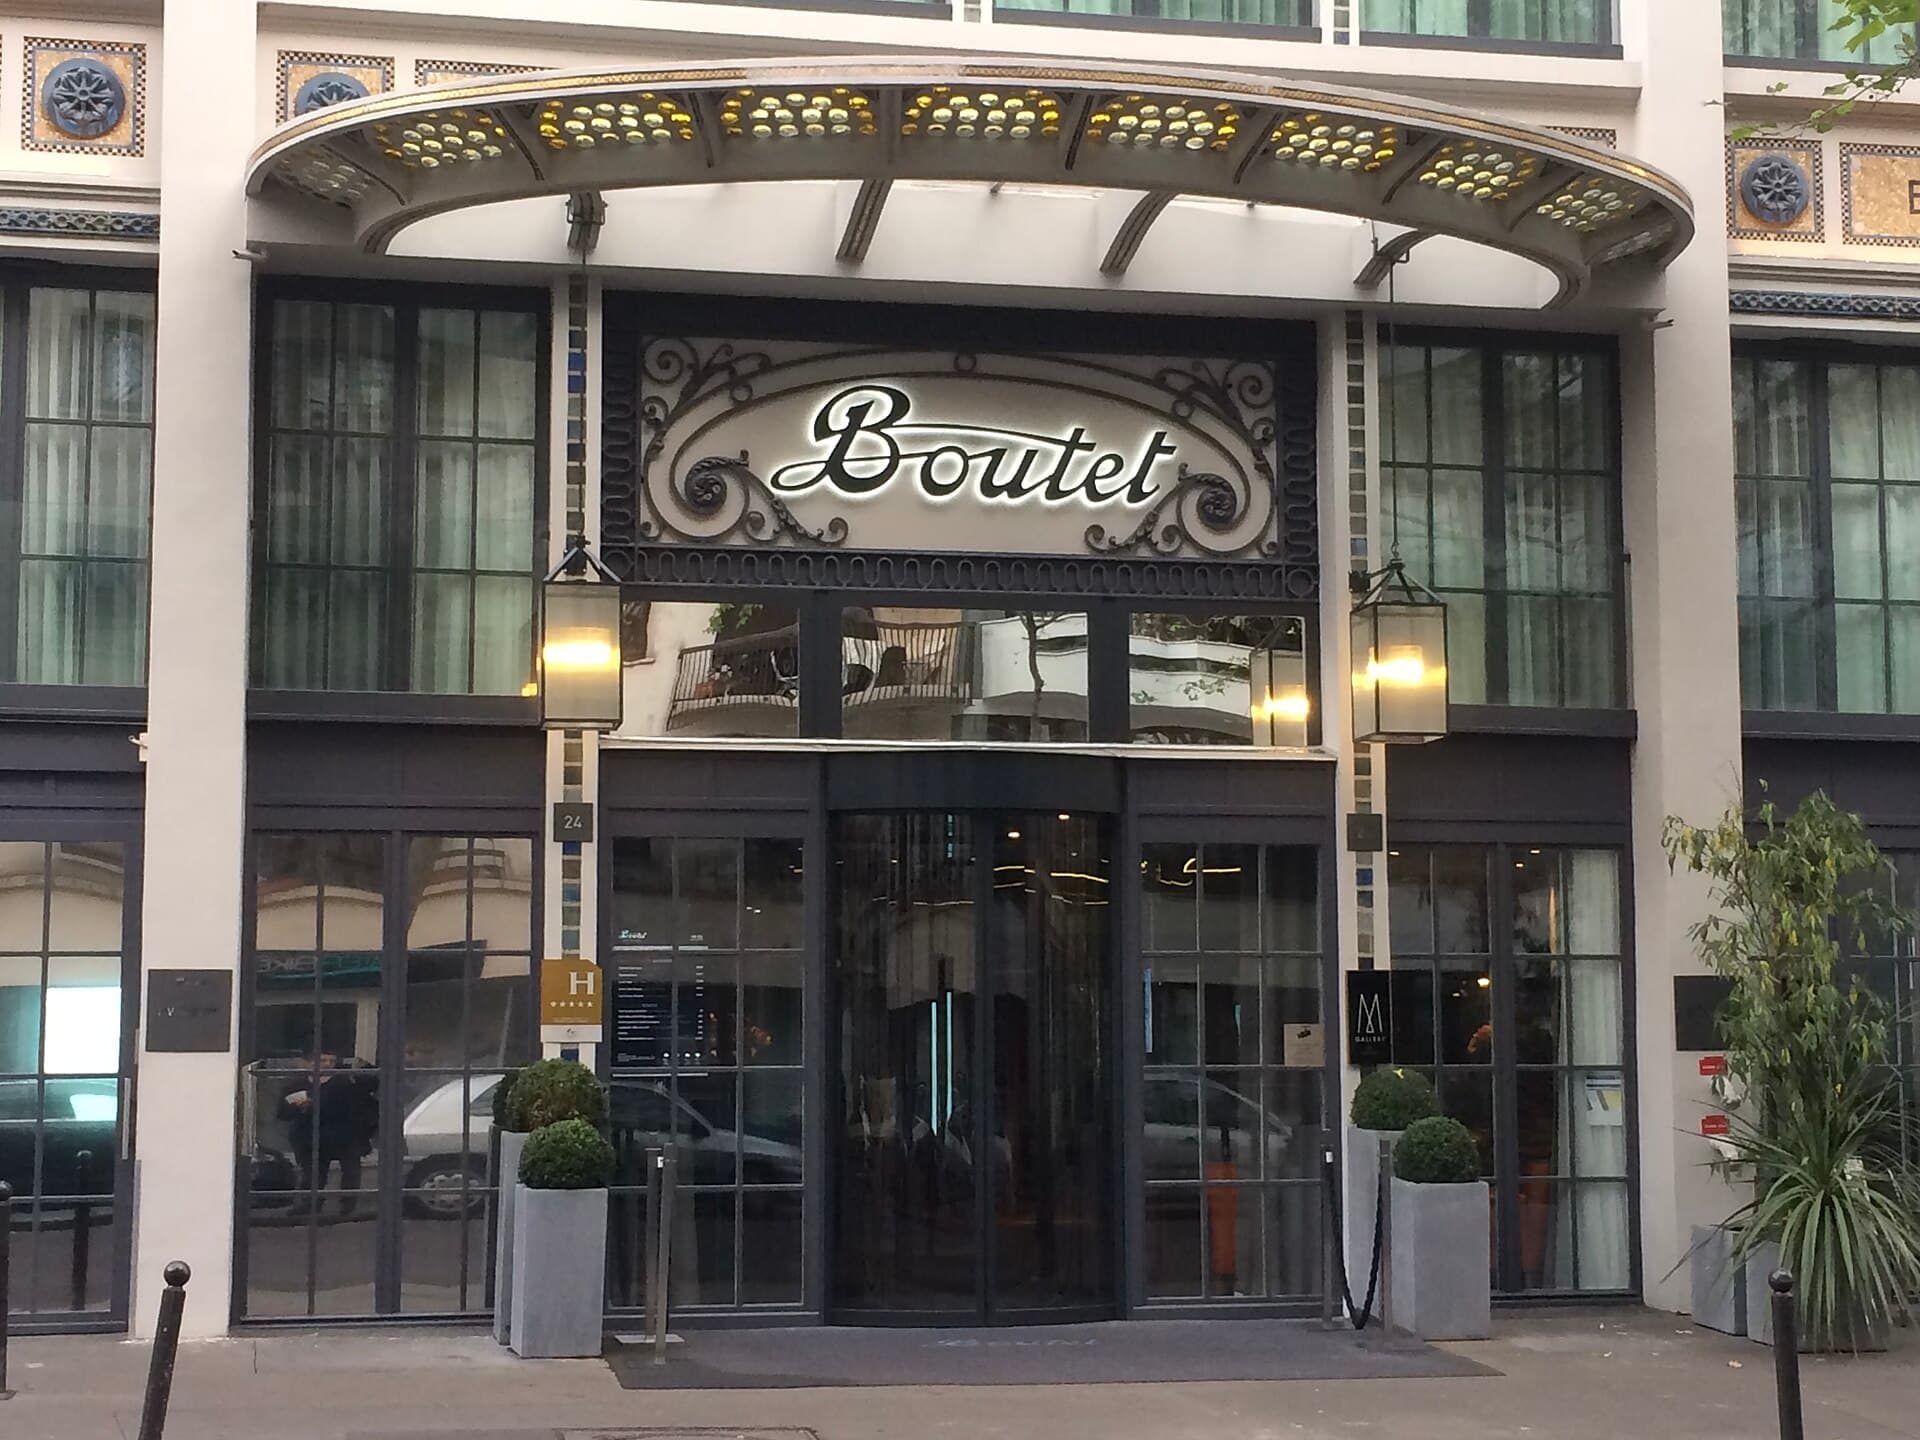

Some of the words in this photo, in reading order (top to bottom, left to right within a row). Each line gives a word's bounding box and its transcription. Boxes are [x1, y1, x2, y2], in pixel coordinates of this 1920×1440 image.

[771, 384, 1177, 503] Boutet
[564, 815, 582, 829] 24
[569, 971, 594, 995] H
